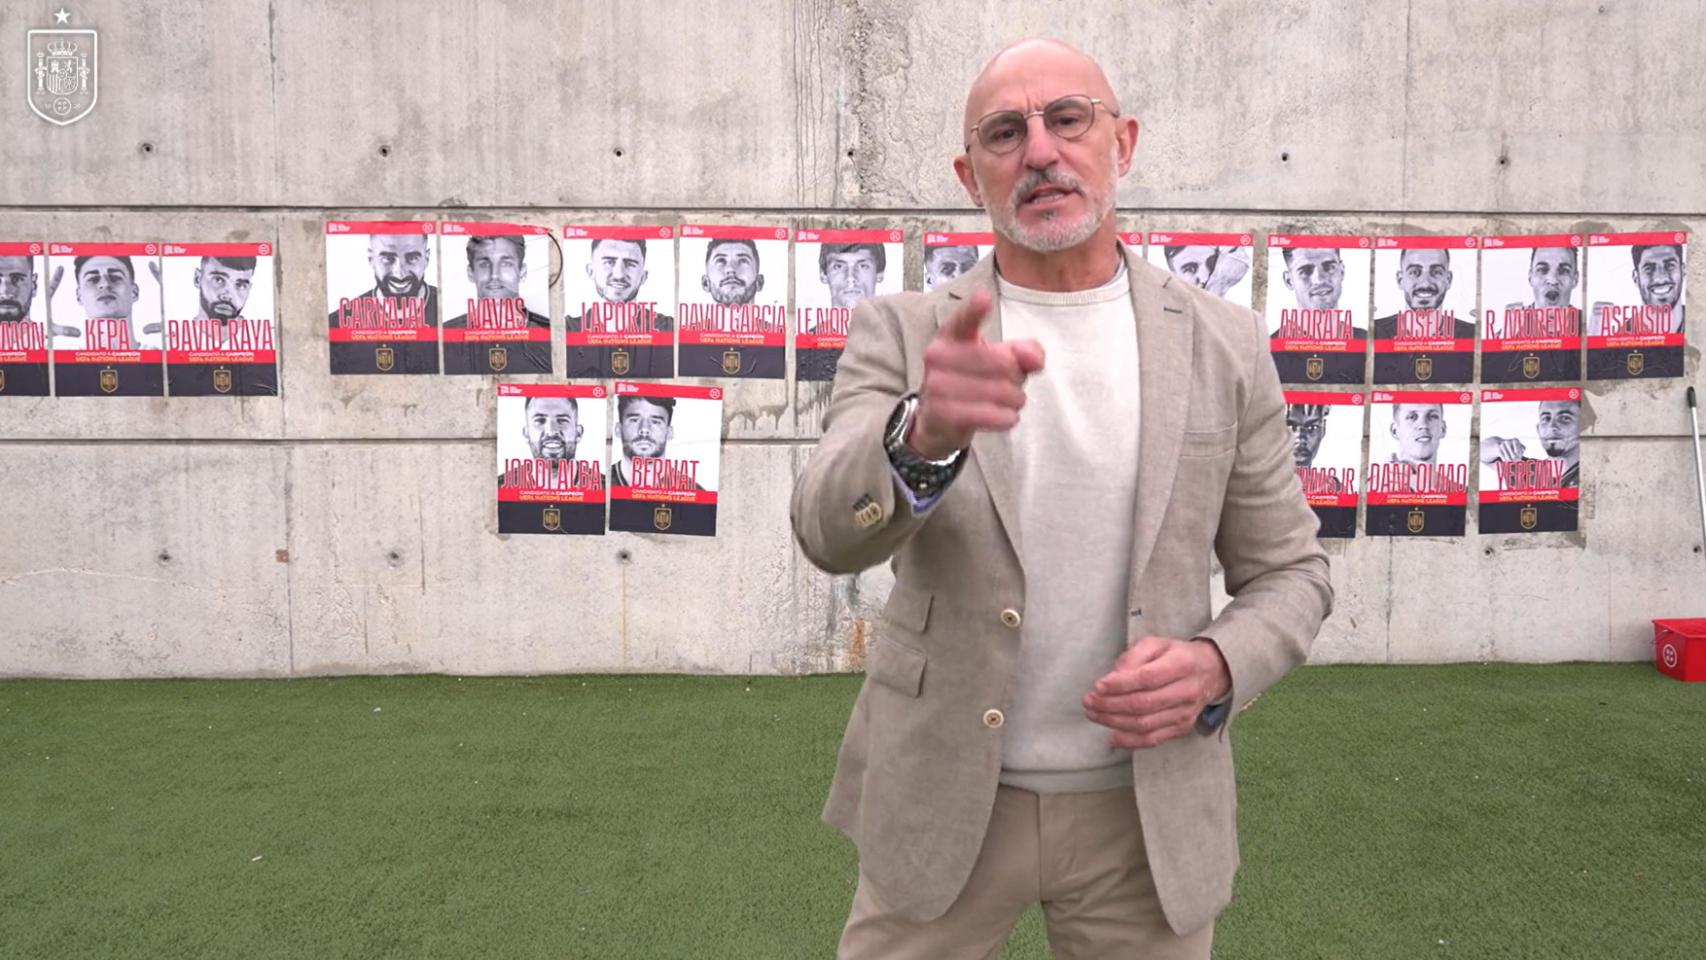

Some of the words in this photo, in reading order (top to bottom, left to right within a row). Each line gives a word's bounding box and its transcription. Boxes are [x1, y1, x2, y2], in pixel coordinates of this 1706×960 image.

[338, 297, 428, 329] CARVAJAL
[467, 298, 528, 329] NAVAS
[581, 301, 658, 332] LAPORTE
[680, 303, 725, 331] DAVID
[730, 300, 786, 333] GARCÍA
[797, 307, 813, 335] LE
[816, 307, 853, 336] NOR
[1278, 309, 1354, 339] MORATA
[1394, 309, 1455, 339] JOSELU
[1601, 304, 1672, 336] ASENSIO
[1, 321, 45, 350] MON
[85, 319, 129, 350] KEPA
[168, 319, 221, 350] DAVID
[228, 319, 273, 350] RAYA
[501, 458, 552, 489] JORDI
[557, 458, 602, 490] ALBA
[631, 457, 700, 490] BERNAT
[1369, 463, 1411, 493] DANI
[1417, 463, 1467, 493] OLMO
[1496, 458, 1564, 489] YEREMY
